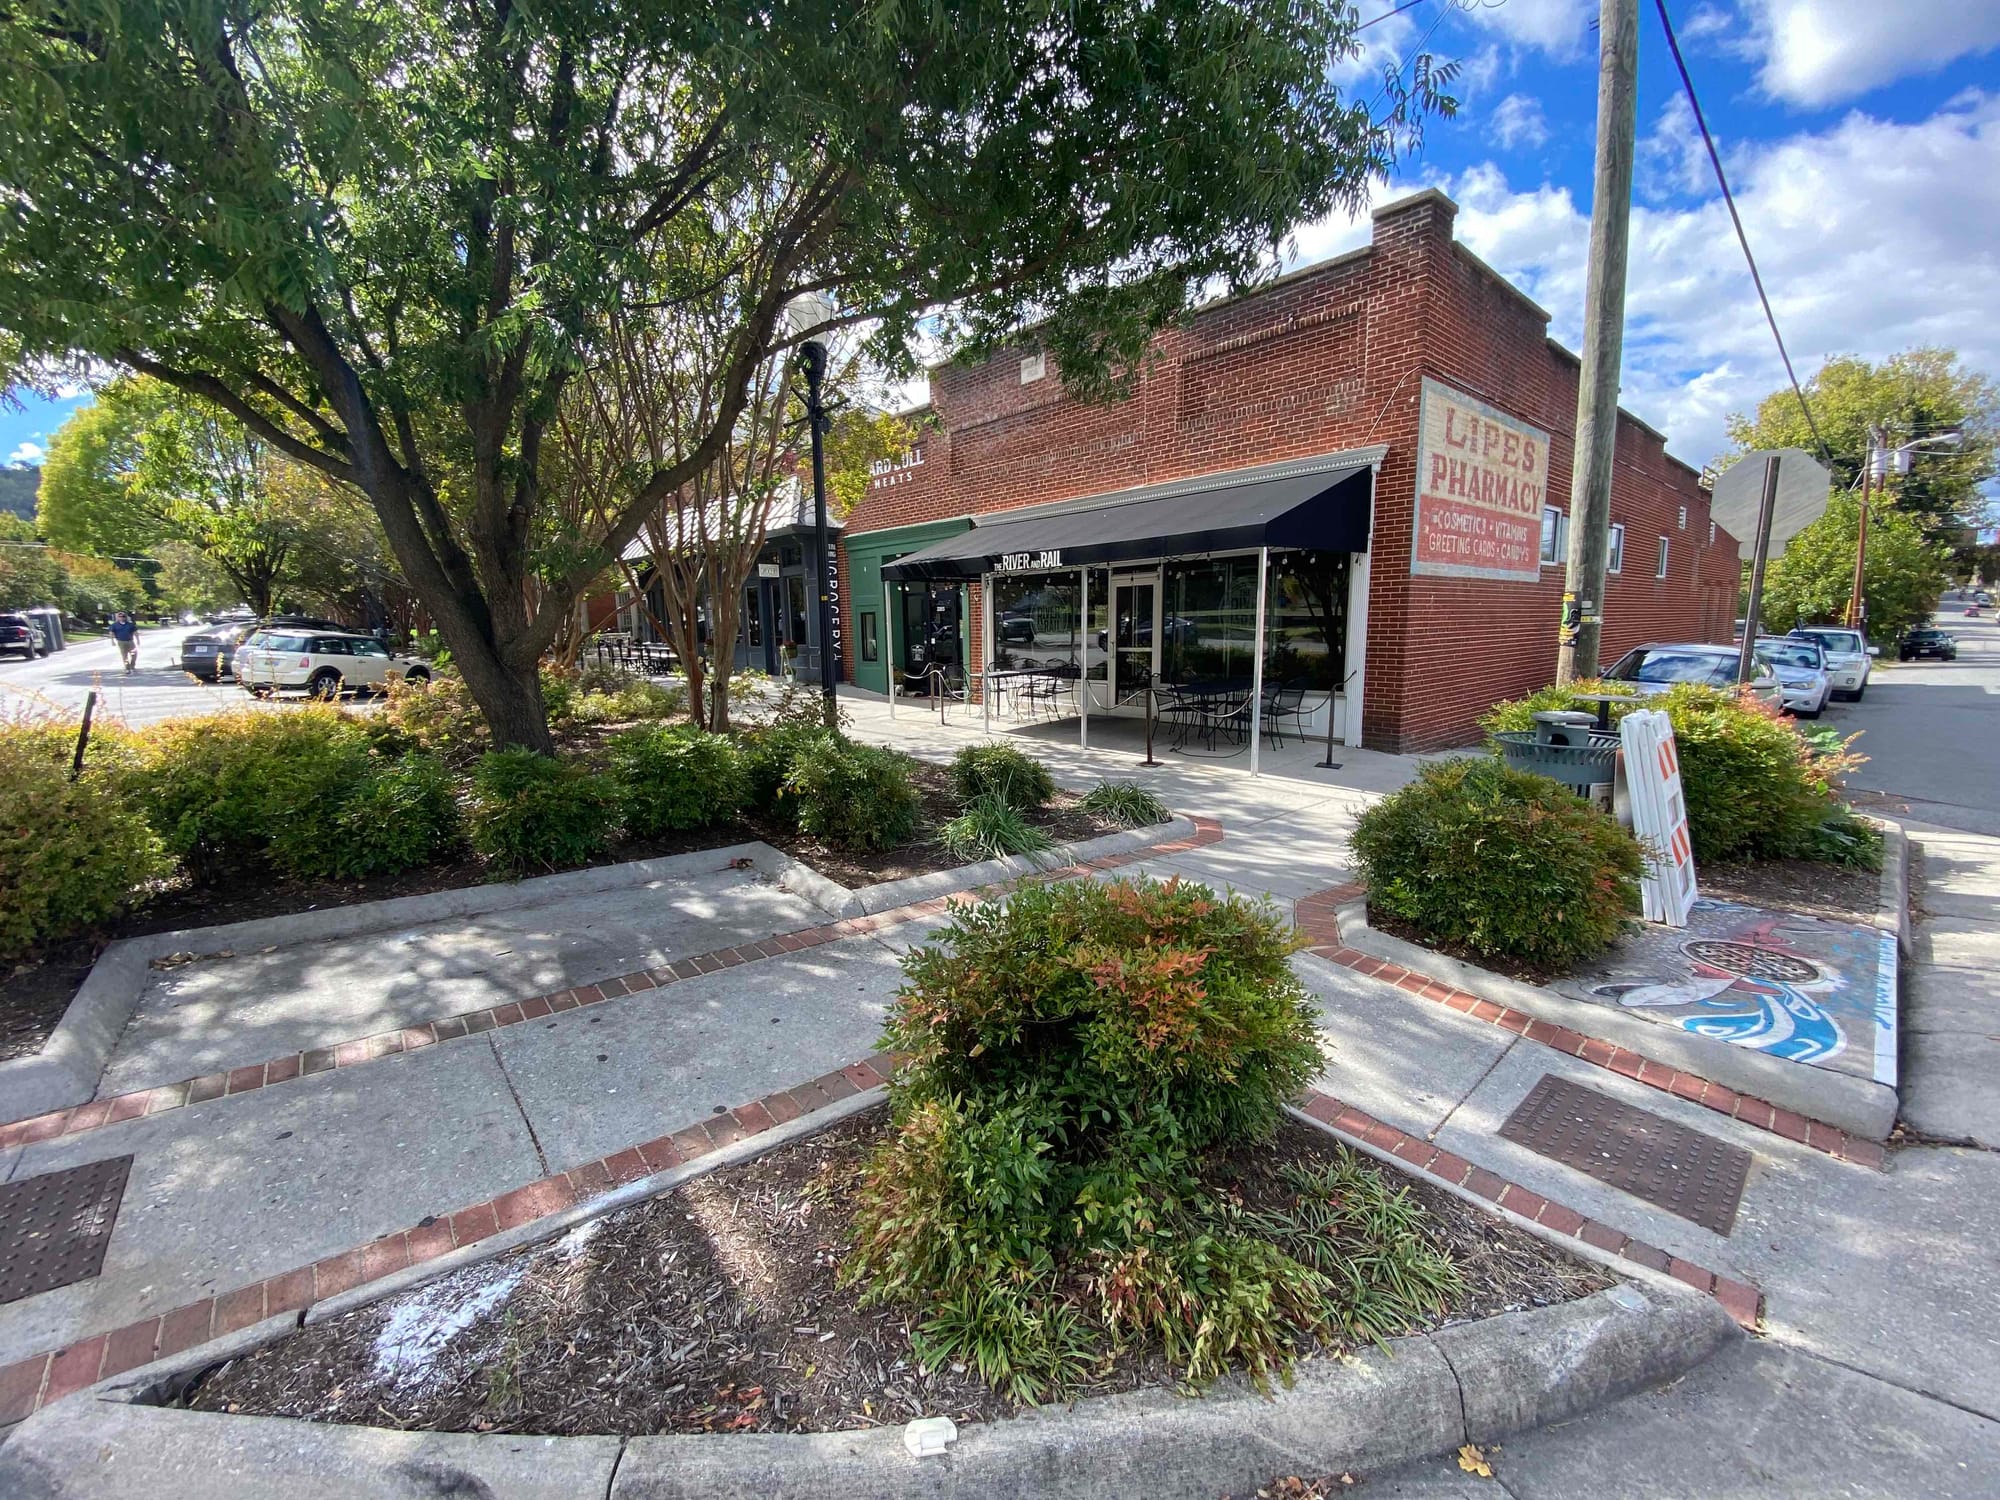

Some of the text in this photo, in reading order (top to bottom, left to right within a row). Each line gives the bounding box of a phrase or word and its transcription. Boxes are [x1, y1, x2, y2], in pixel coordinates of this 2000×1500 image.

[1444, 406, 1536, 474] LIPES
[869, 458, 892, 476] ARD
[874, 471, 913, 489] MEATS
[1431, 452, 1541, 515] PHARMACY
[1437, 509, 1487, 535] COSMETICS
[1429, 532, 1470, 555] GREETING
[1473, 539, 1496, 558] CARDS
[994, 550, 1063, 571] THE RIVER AND RAIL
